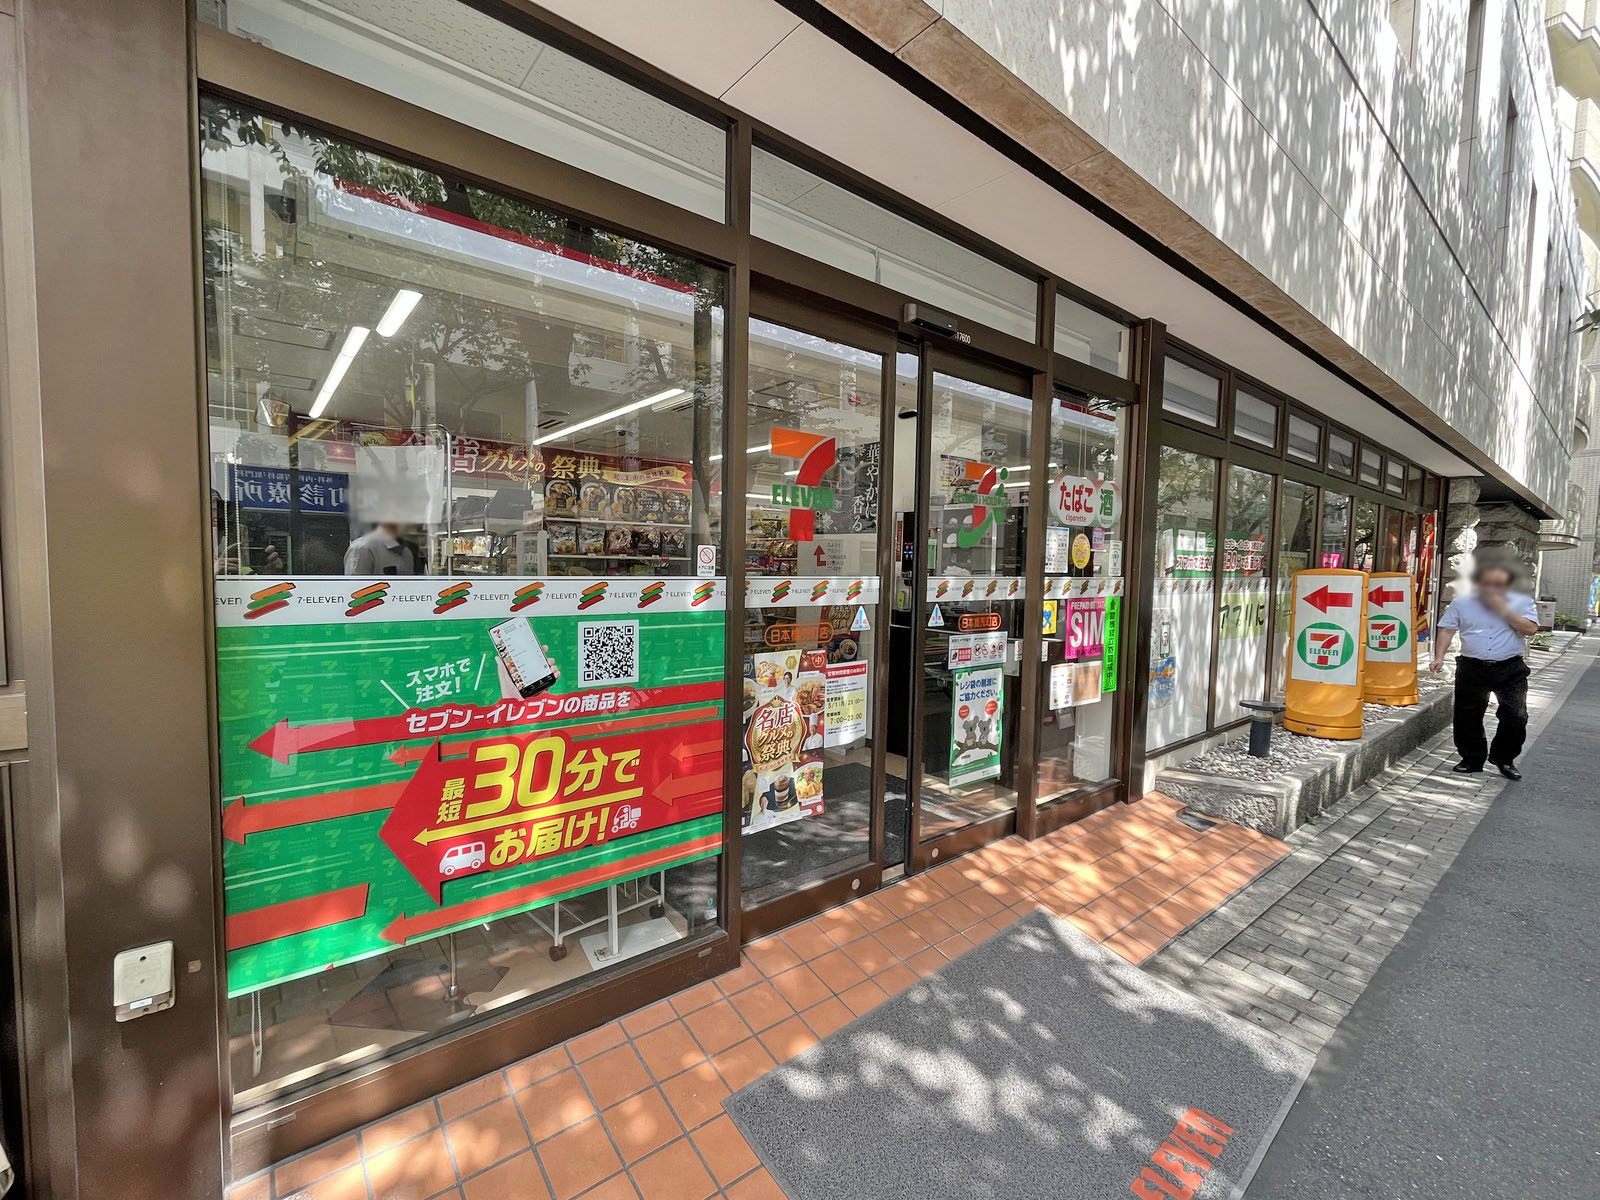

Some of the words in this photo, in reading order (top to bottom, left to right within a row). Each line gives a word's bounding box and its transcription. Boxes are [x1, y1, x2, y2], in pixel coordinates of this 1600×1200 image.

[481, 449, 546, 473] グルメの
[551, 454, 602, 480] 祭典
[1059, 481, 1094, 514] たばこ
[1099, 488, 1114, 517] 酒
[1069, 610, 1105, 648] SIM
[406, 658, 471, 690] スマホで
[415, 676, 462, 703] 注文!
[757, 704, 796, 732] 名店
[758, 728, 794, 747] グルメの
[761, 741, 791, 763] 祭典
[438, 778, 466, 823] 最短
[466, 735, 642, 820] 30分で
[490, 807, 608, 866] お届け!
